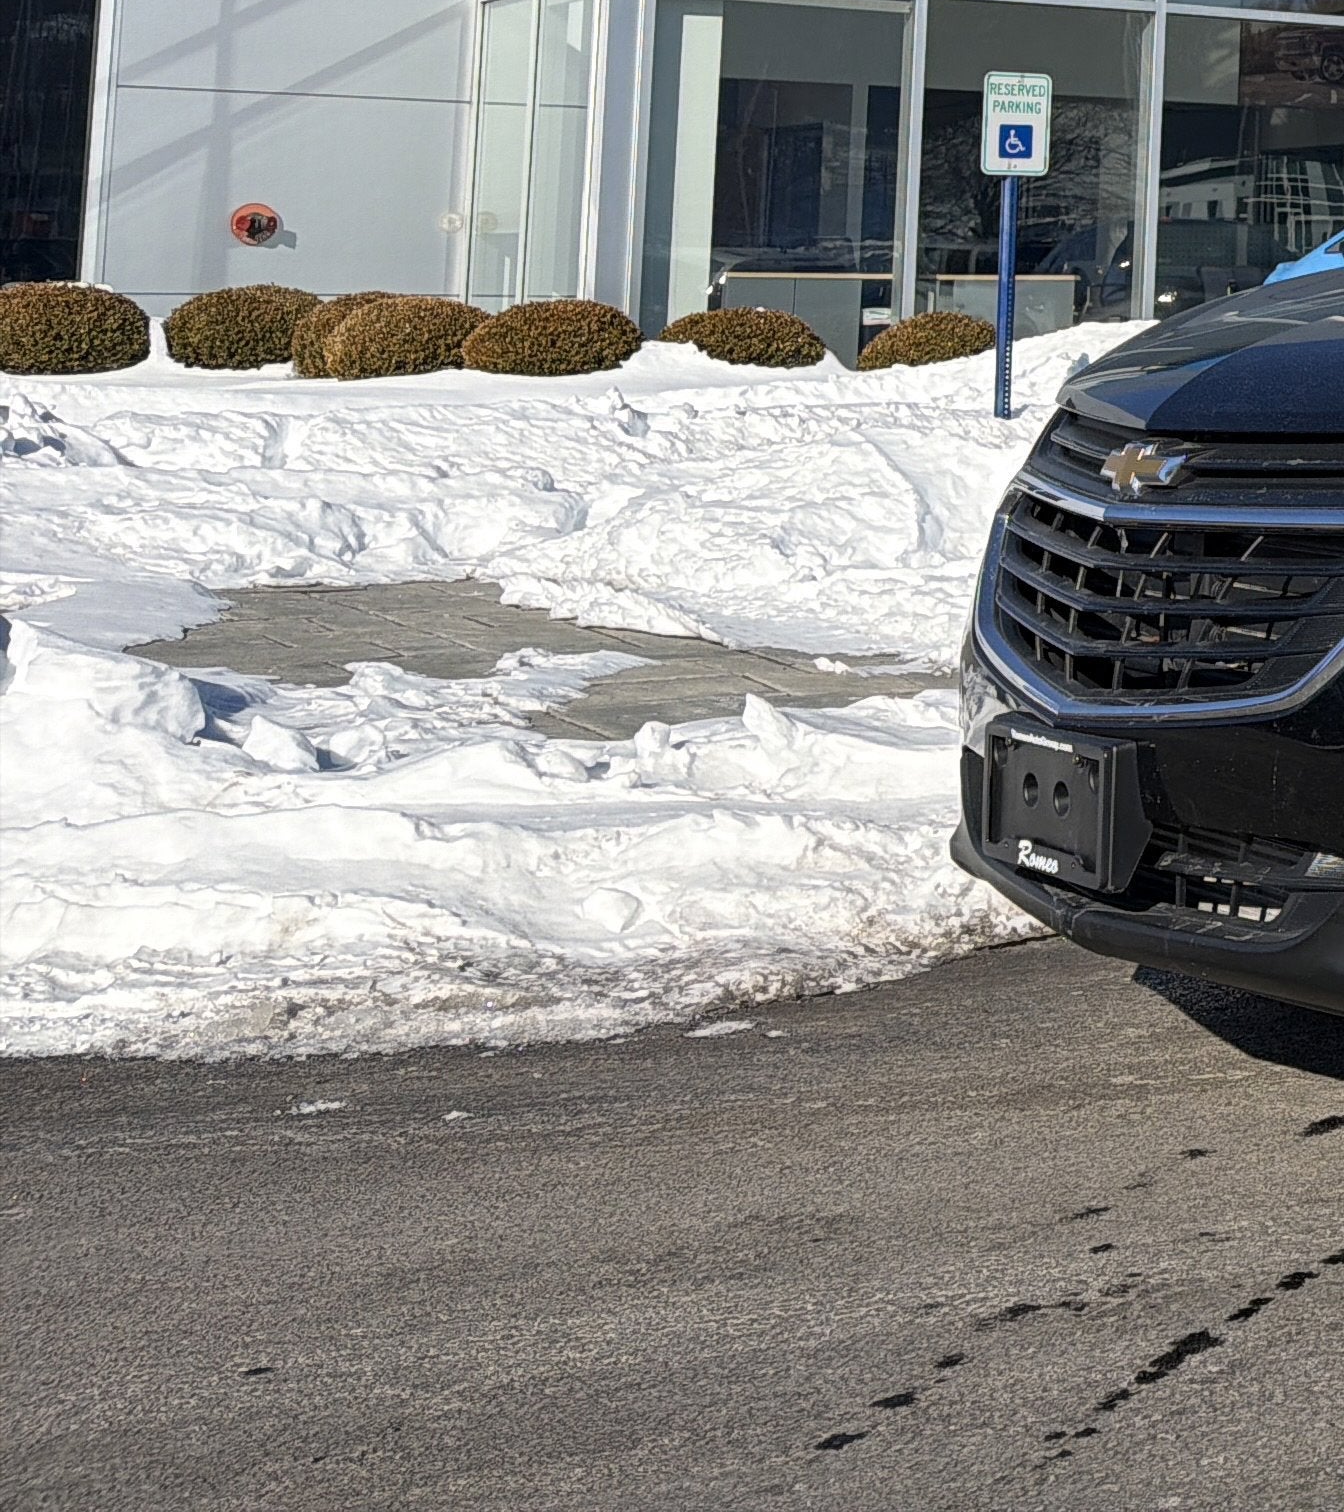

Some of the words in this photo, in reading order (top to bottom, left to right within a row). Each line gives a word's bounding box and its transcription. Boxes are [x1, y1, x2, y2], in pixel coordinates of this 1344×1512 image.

[989, 82, 1046, 98] RESERVED
[992, 99, 1042, 115] PARKING
[1016, 839, 1059, 875] Romeo
